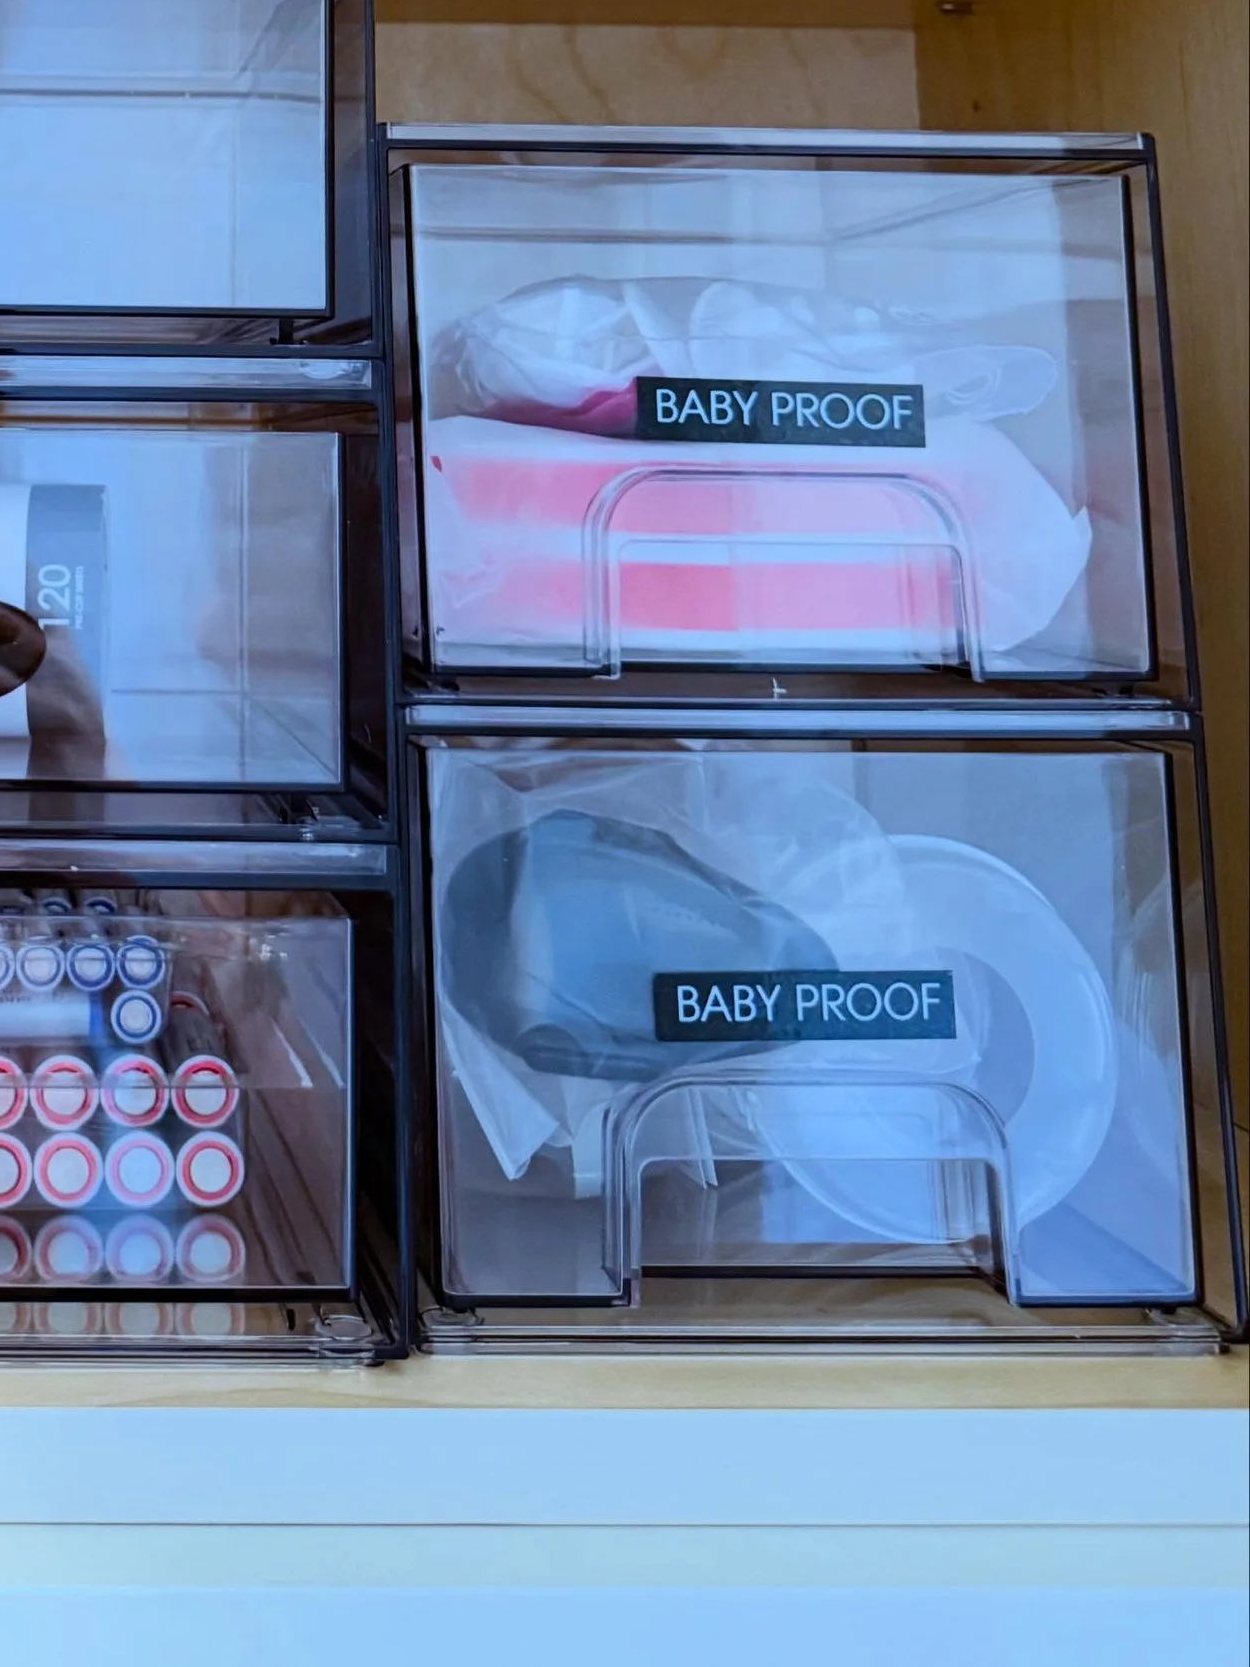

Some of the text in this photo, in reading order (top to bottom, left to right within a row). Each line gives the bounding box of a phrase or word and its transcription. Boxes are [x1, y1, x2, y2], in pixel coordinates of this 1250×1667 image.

[655, 388, 914, 430] BABY PROOF
[37, 563, 72, 632] 120
[677, 982, 941, 1023] BABY PROOF
